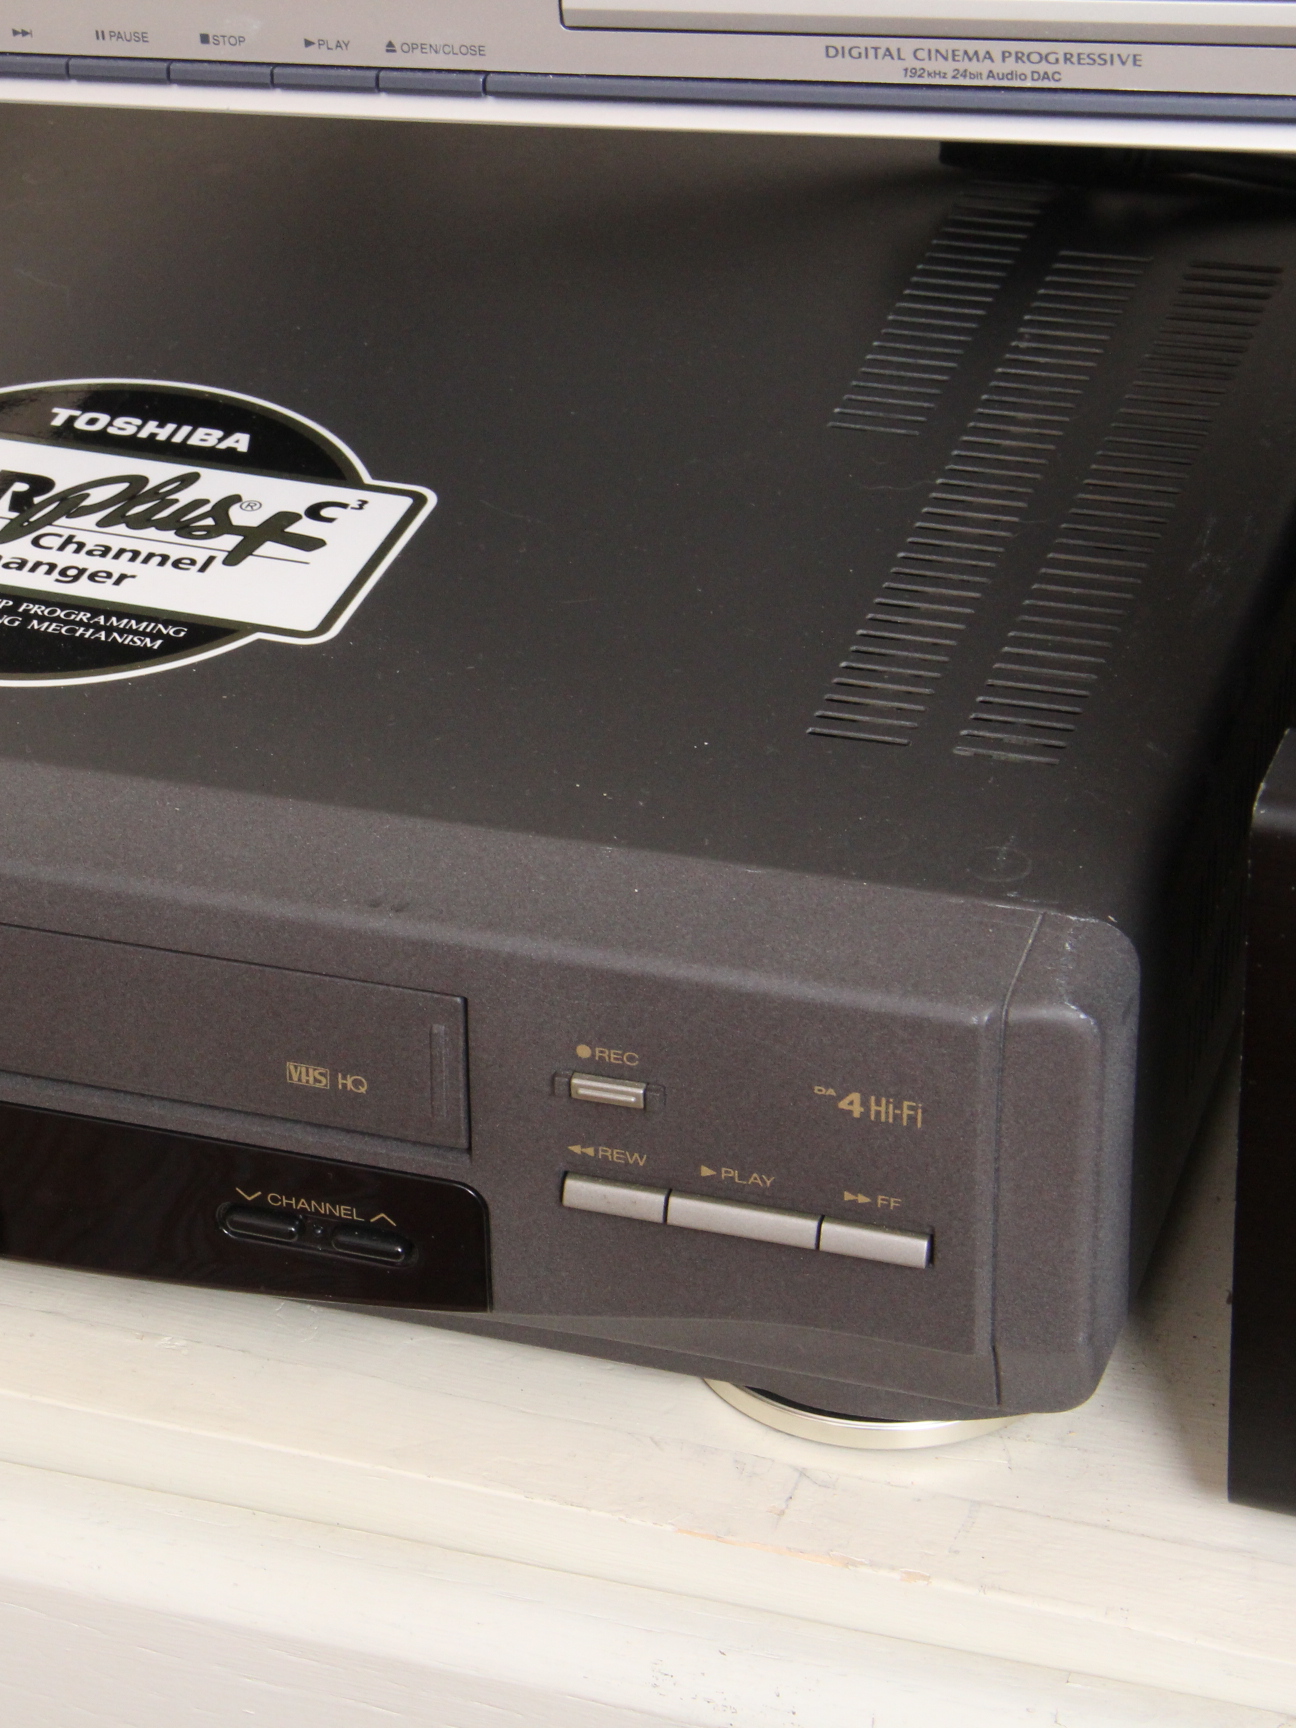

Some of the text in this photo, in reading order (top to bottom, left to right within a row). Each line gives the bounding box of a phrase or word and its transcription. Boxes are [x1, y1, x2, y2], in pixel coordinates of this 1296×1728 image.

[109, 31, 149, 43] PAUSE
[212, 35, 246, 47] STOP
[318, 38, 350, 51] PLAY
[401, 42, 486, 57] OPEN/CLOSE
[825, 45, 1142, 67] DIGITAL CINEMA PROGRESSIVE
[903, 67, 1062, 82] 192kHz 24bit Audio DAC
[50, 407, 251, 453] TOSHIBA
[30, 532, 218, 574] Channel
[17, 602, 188, 638] PROGRAMMING
[27, 619, 163, 650] MECHANISM
[595, 1047, 639, 1066] REC
[288, 1063, 368, 1094] VHS HQ
[837, 1092, 864, 1118] 4
[870, 1095, 923, 1129] Hi-Fi
[599, 1147, 647, 1167] REW
[721, 1167, 775, 1188] PLAY
[267, 1193, 365, 1222] CHANNEL
[877, 1195, 902, 1211] FF
